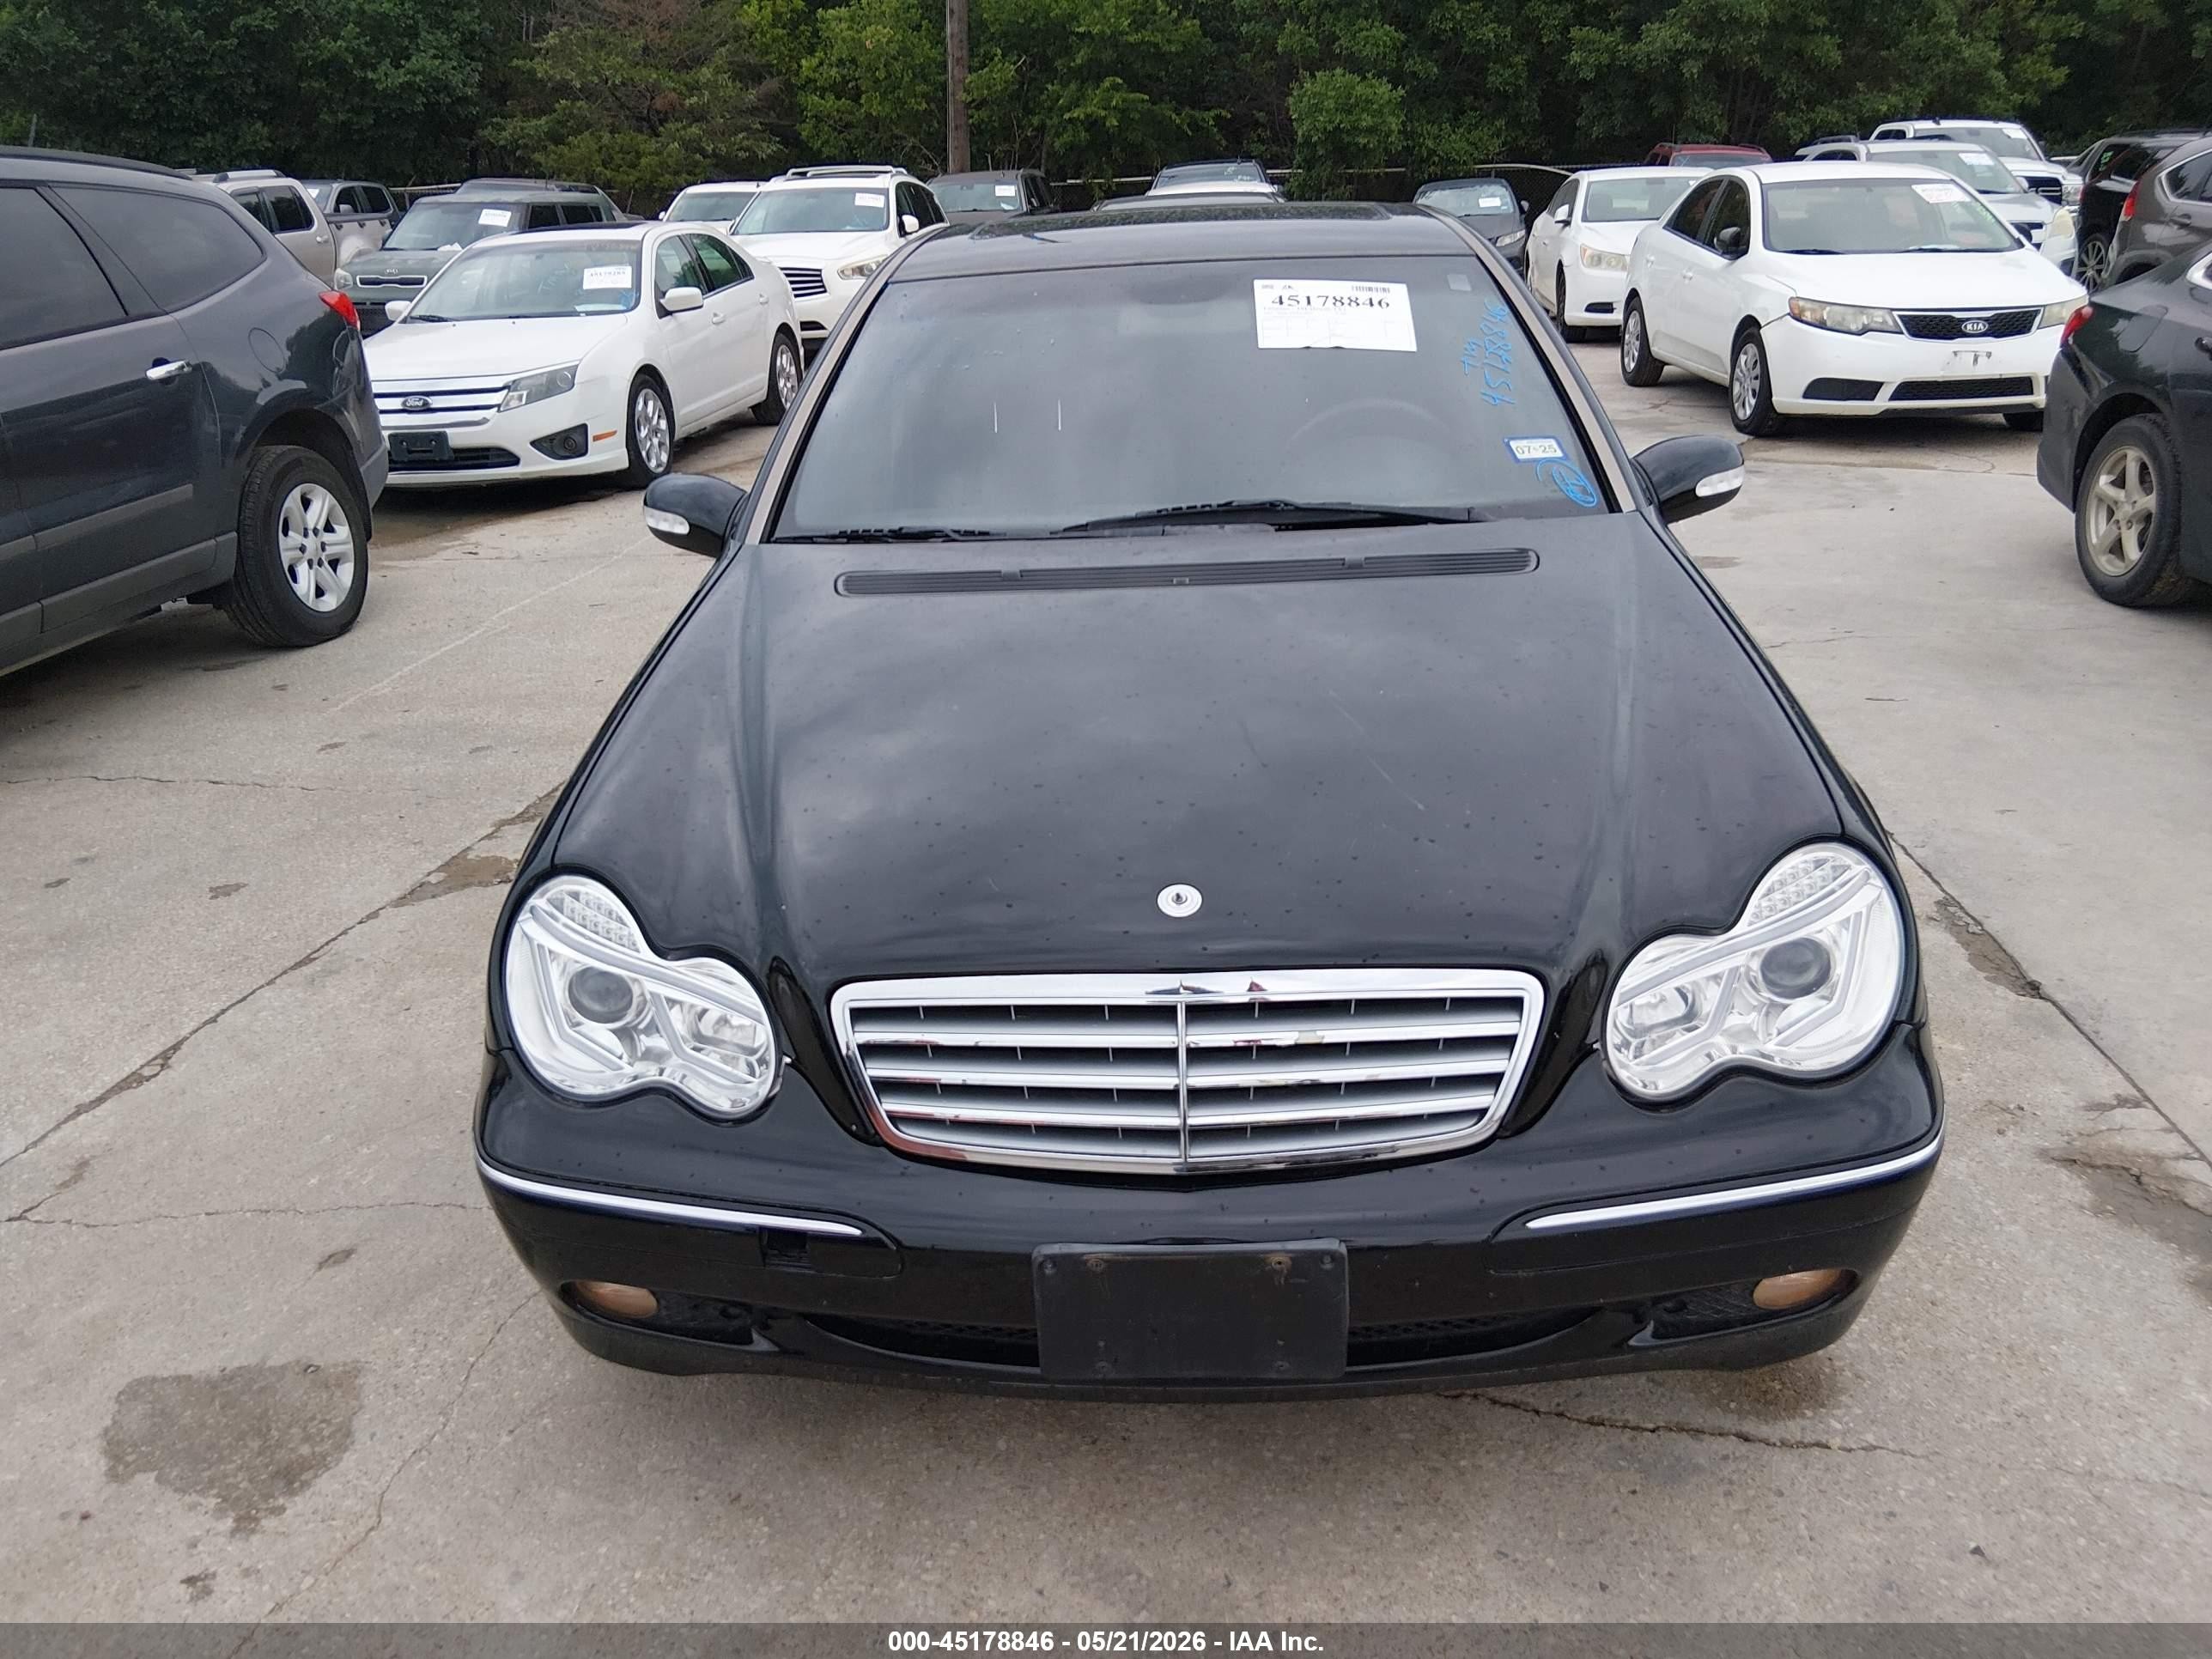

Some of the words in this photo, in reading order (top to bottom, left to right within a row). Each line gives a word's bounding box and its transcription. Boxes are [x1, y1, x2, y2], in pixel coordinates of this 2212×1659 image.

[1272, 294, 1390, 310] 45178846
[1966, 322, 1984, 331] KIA
[406, 398, 424, 407] Ford
